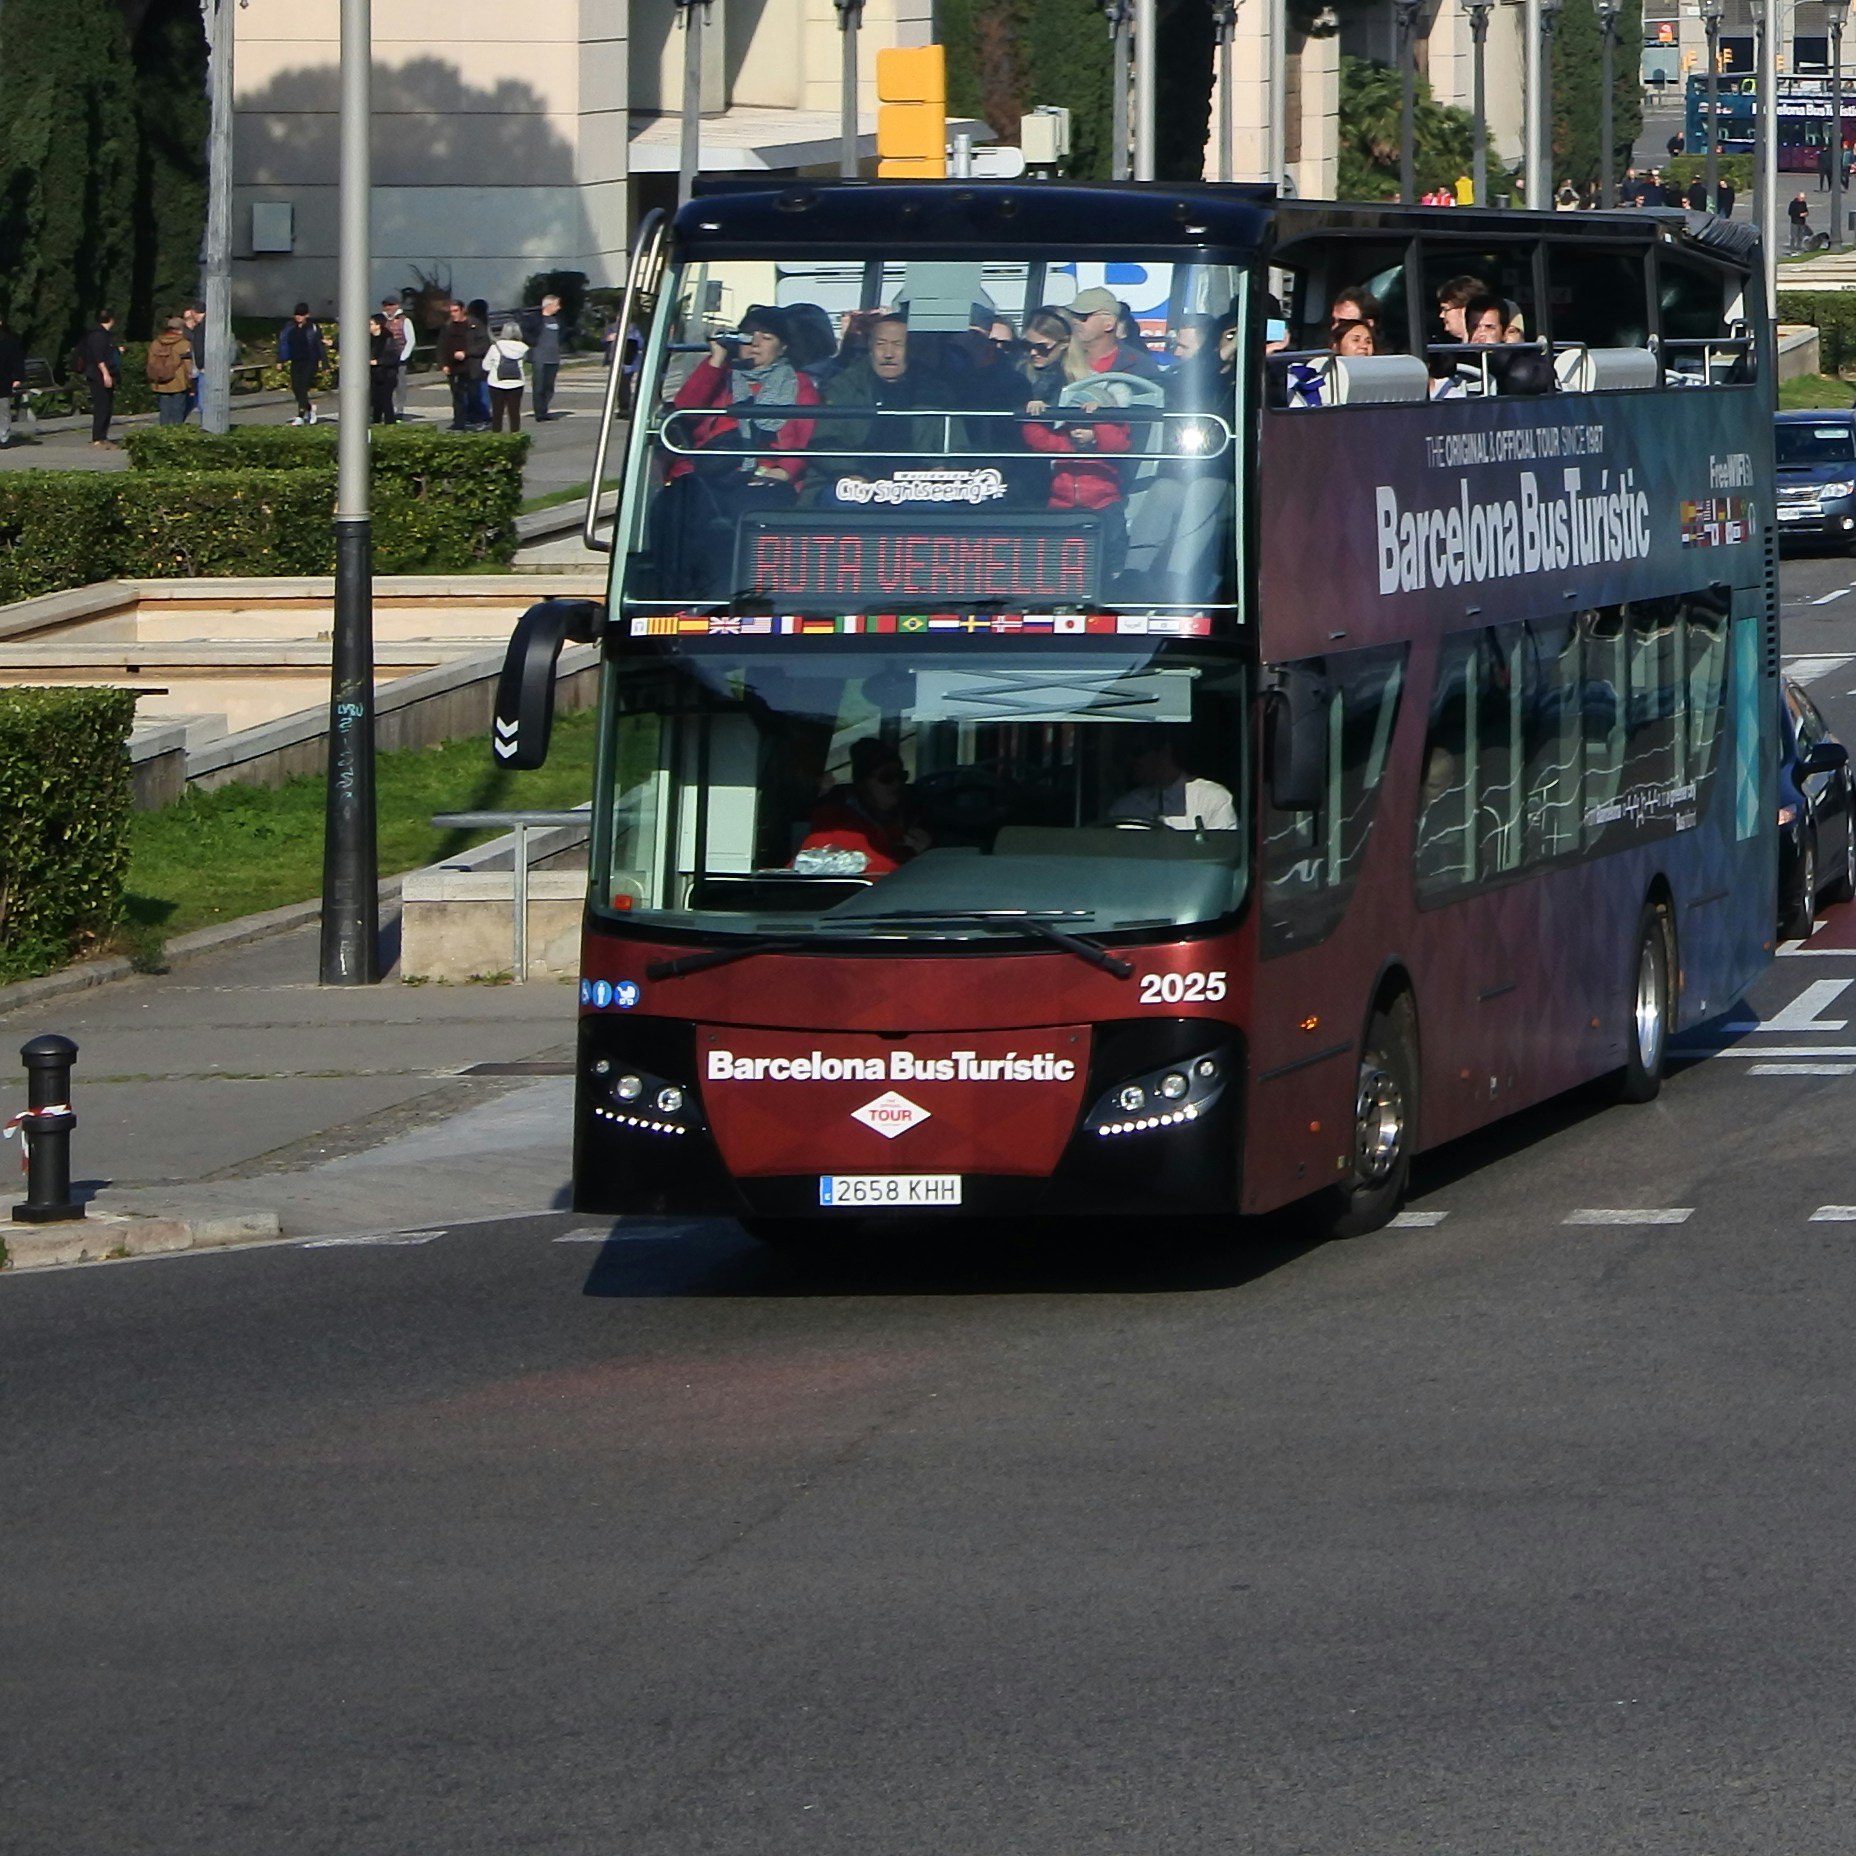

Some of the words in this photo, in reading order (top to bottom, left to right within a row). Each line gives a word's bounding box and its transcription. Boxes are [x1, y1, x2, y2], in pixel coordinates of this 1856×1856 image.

[1445, 432, 1489, 467] ORIGINAL
[1496, 428, 1536, 462] OFFICIAL
[1536, 427, 1560, 457] TOUR
[1561, 425, 1586, 456] SINCE
[1376, 477, 1520, 596] Barcelona
[1519, 466, 1650, 574] BusTurístic
[757, 535, 863, 594] RUTA
[877, 536, 1087, 594] VERMELLA
[1139, 972, 1228, 1005] 2025
[707, 1050, 886, 1081] Barcelona
[890, 1050, 1076, 1081] BusTurístic
[869, 1109, 912, 1122] TOUR
[837, 1180, 899, 1201] 2658
[908, 1180, 956, 1201] KHH
